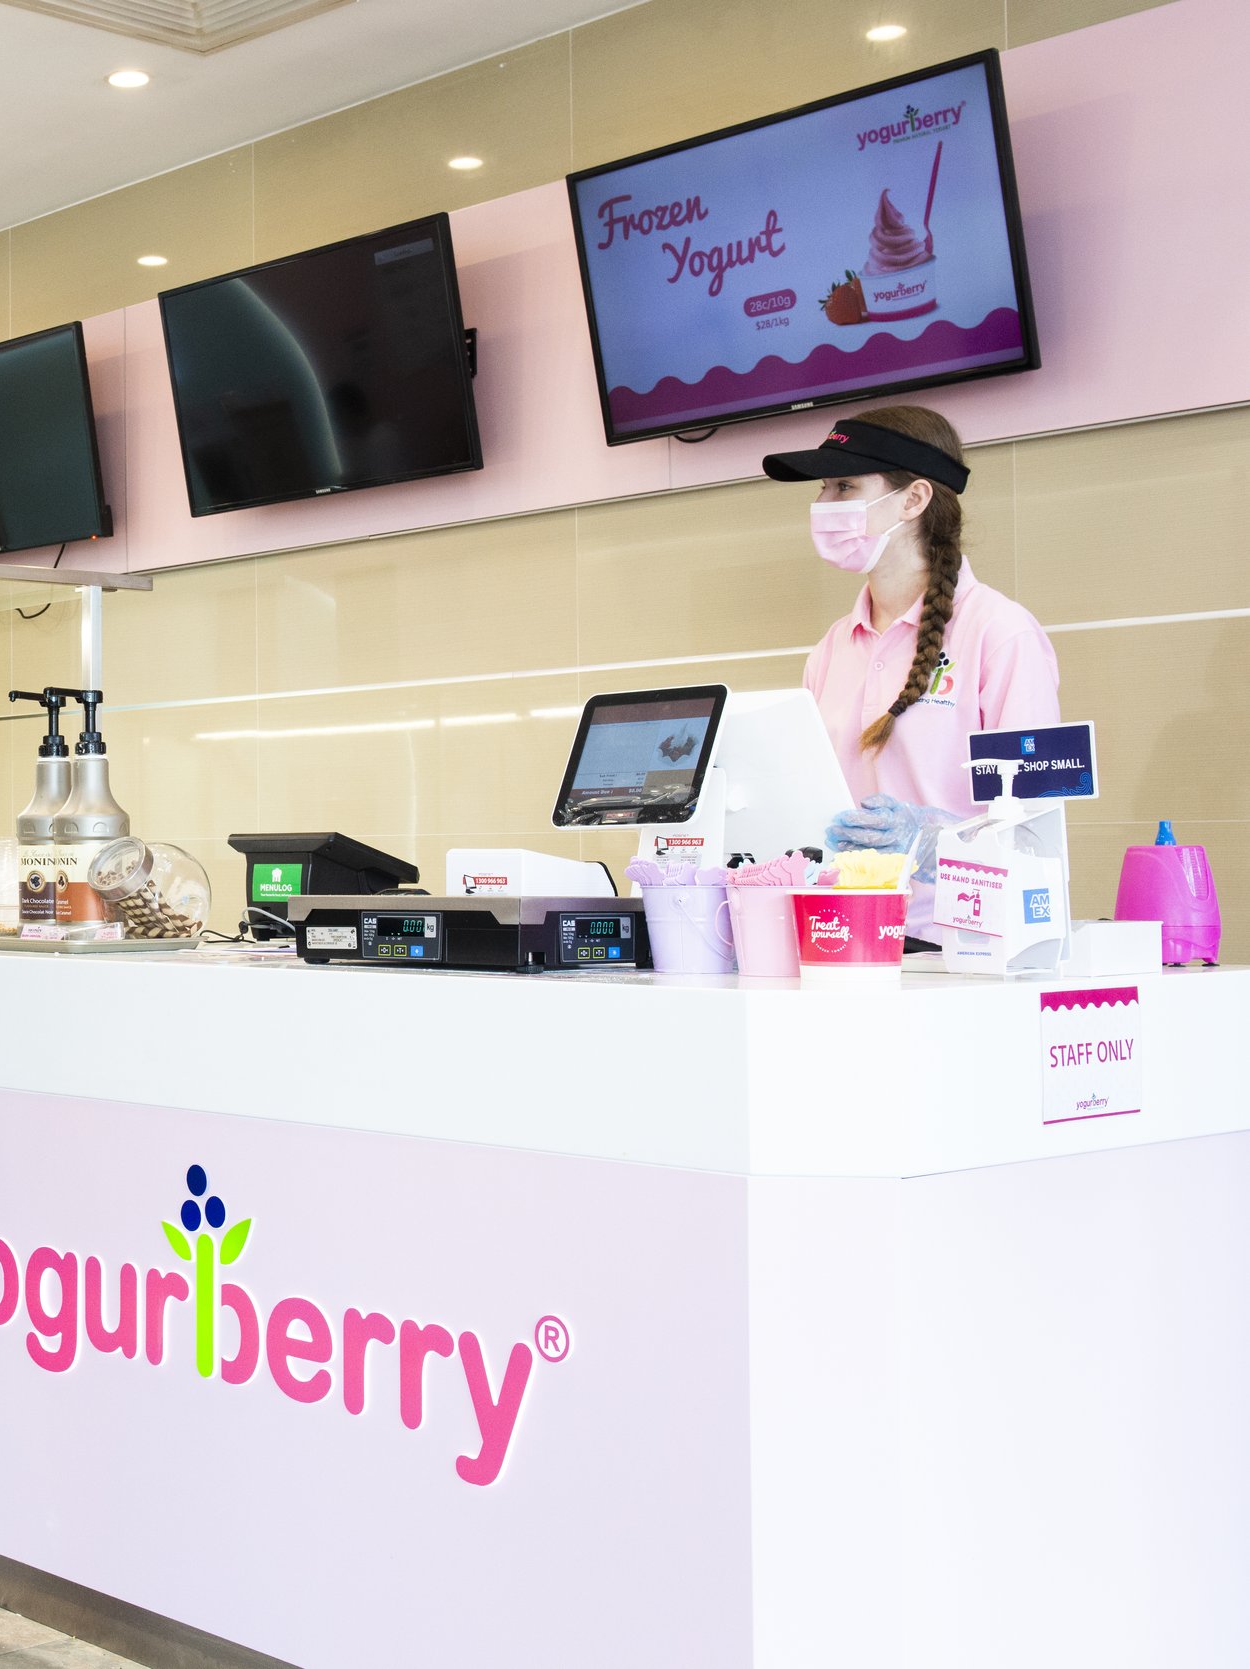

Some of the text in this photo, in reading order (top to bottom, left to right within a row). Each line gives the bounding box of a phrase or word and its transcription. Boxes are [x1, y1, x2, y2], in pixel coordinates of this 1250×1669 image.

[597, 194, 709, 250] Frozen
[662, 209, 786, 297] Yogurt
[750, 296, 792, 312] 28c/10g
[756, 316, 790, 331] $28/1kg
[975, 764, 997, 775] STAY
[1023, 761, 1049, 771] SHOP
[1051, 758, 1085, 770] SMALL.
[21, 857, 55, 866] MONIN
[260, 883, 293, 892] MENULOG
[940, 872, 1003, 889] USE HAND SANITISER
[1031, 894, 1050, 906] AM
[426, 923, 435, 932] kg
[808, 915, 841, 931] Treat
[1049, 1038, 1134, 1068] STAFF ONLY
[1076, 1096, 1109, 1111] yogurberry
